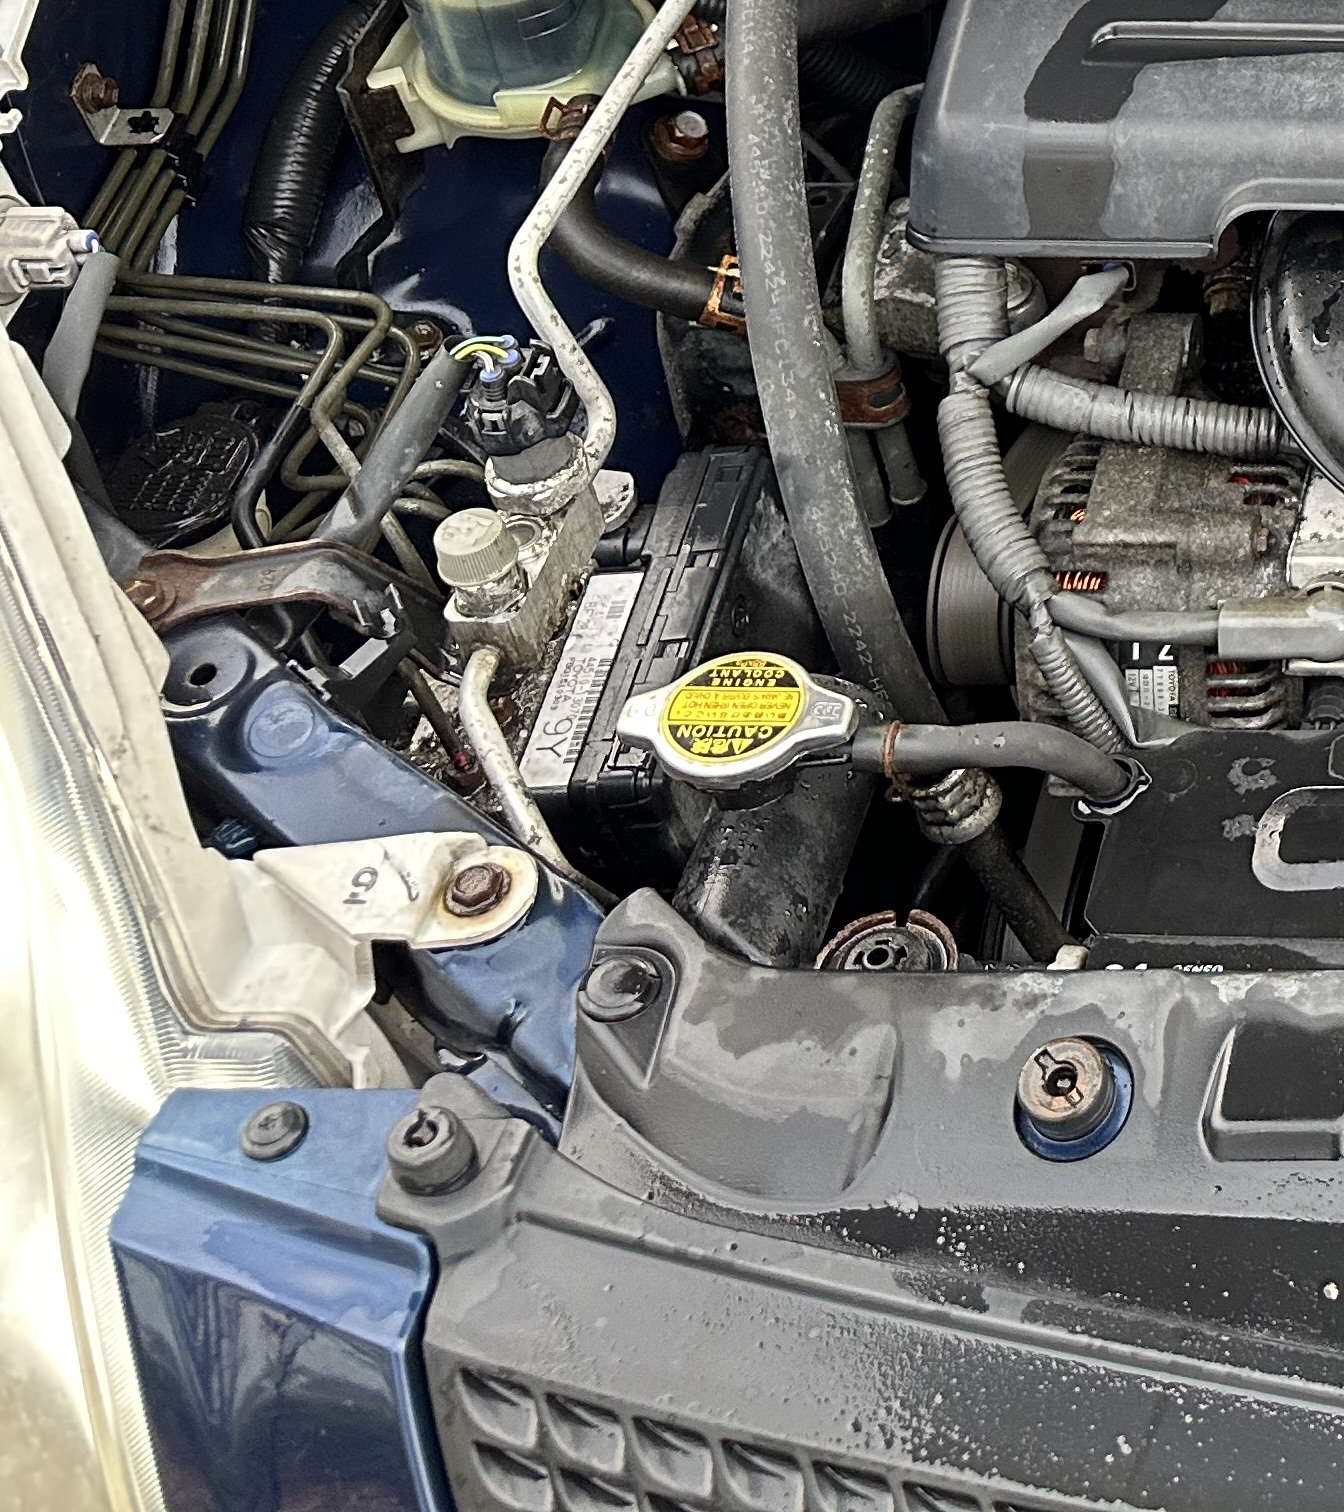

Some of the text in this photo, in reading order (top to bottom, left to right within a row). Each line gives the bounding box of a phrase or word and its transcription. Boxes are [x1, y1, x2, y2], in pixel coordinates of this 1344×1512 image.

[561, 656, 588, 703] TOYOTA
[708, 669, 784, 677] COOLANT
[677, 724, 772, 737] CAUTION
